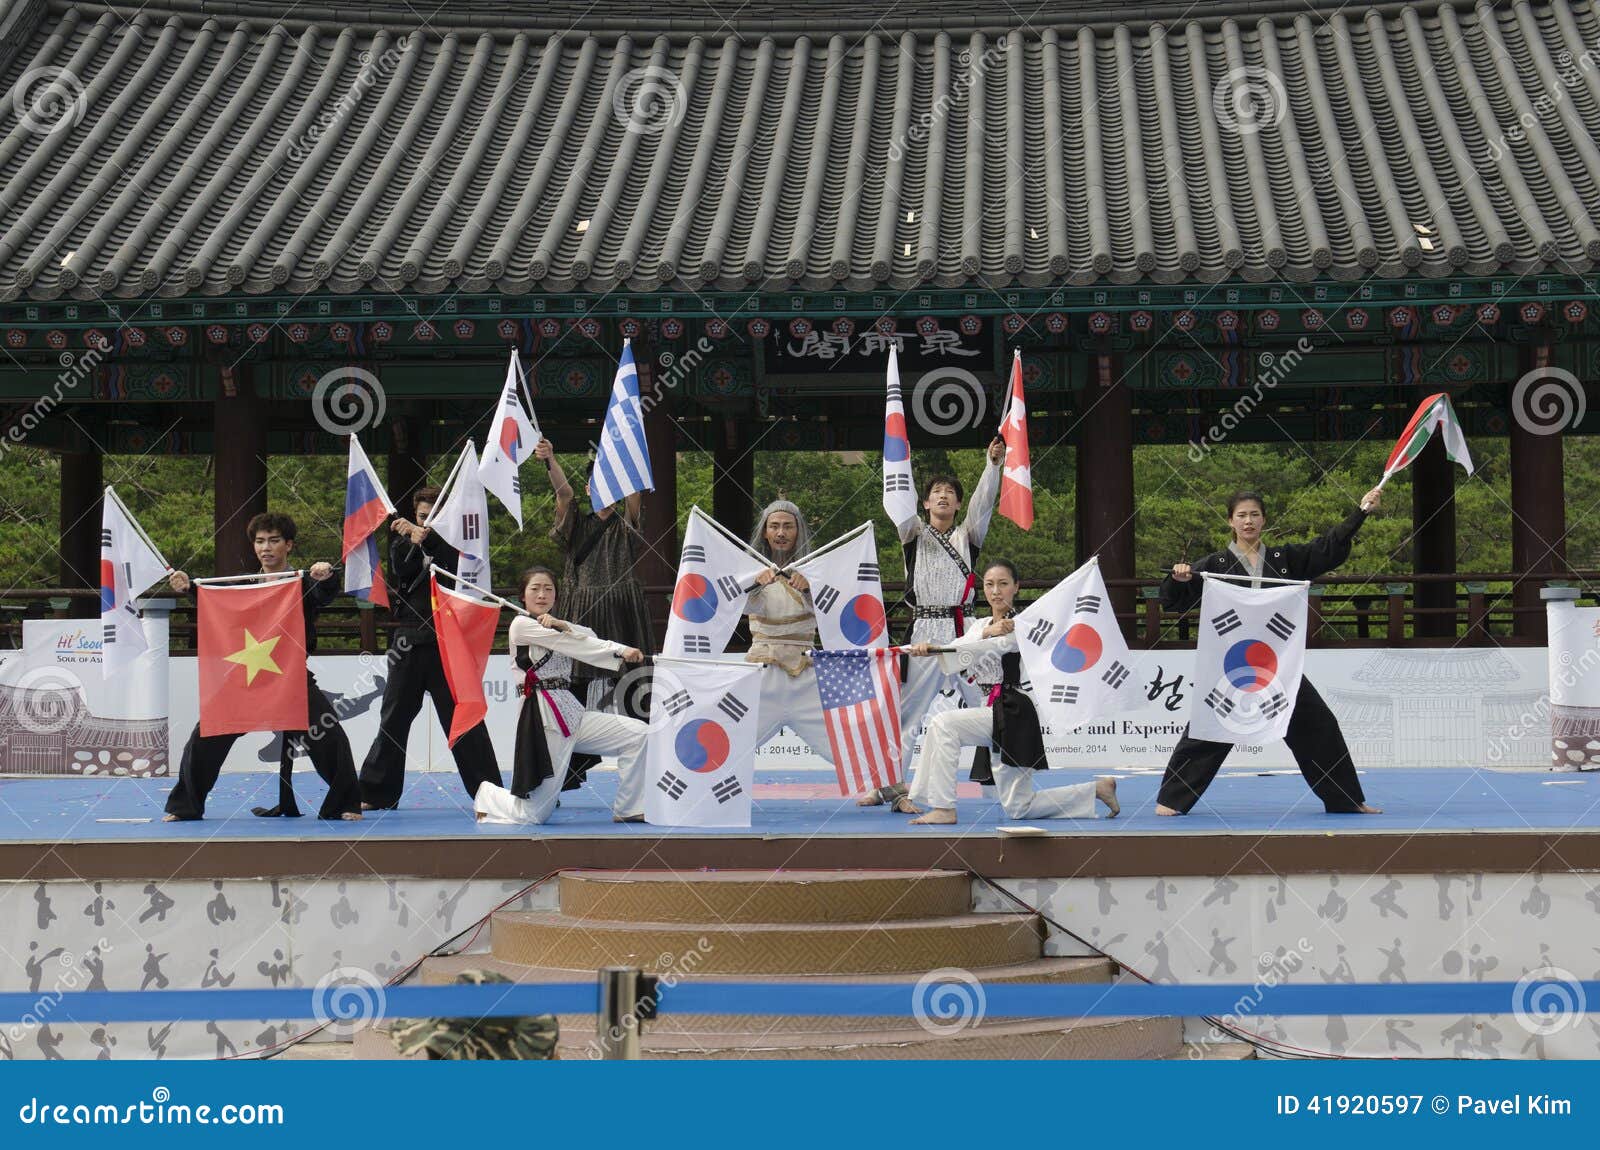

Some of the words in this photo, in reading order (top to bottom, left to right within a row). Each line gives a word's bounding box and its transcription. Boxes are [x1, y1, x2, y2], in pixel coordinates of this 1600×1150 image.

[76, 636, 103, 649] Seou
[1088, 721, 1116, 735] and
[1122, 721, 1184, 738] Experie
[1044, 744, 1084, 754] ovember,
[1086, 744, 1108, 753] 2014
[1120, 744, 1147, 753] Venue
